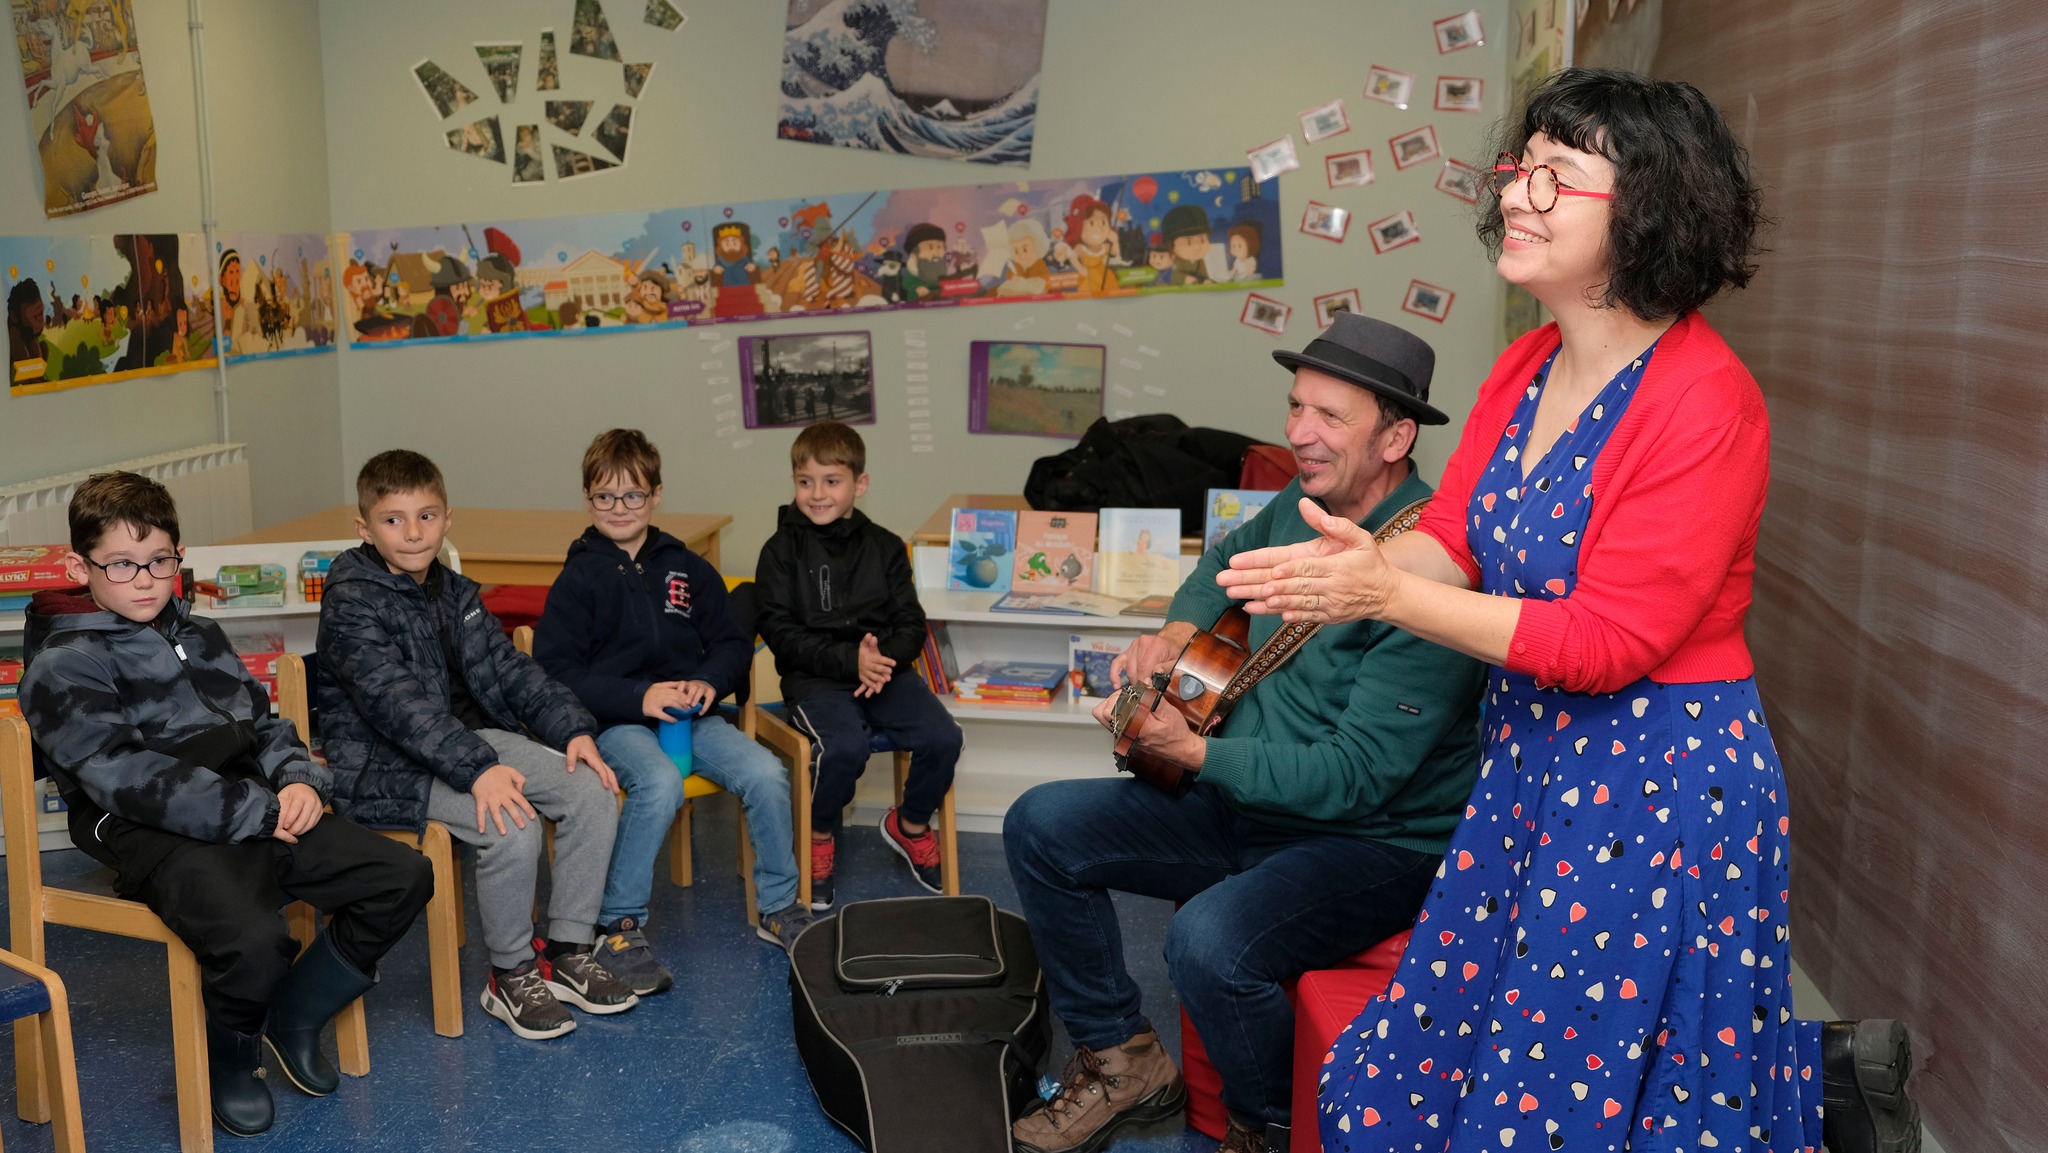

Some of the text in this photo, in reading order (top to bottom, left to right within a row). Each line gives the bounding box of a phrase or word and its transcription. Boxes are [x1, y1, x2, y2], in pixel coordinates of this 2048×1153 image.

[5, 572, 27, 581] LYNX
[463, 607, 482, 623] ONE
[606, 934, 631, 952] N
